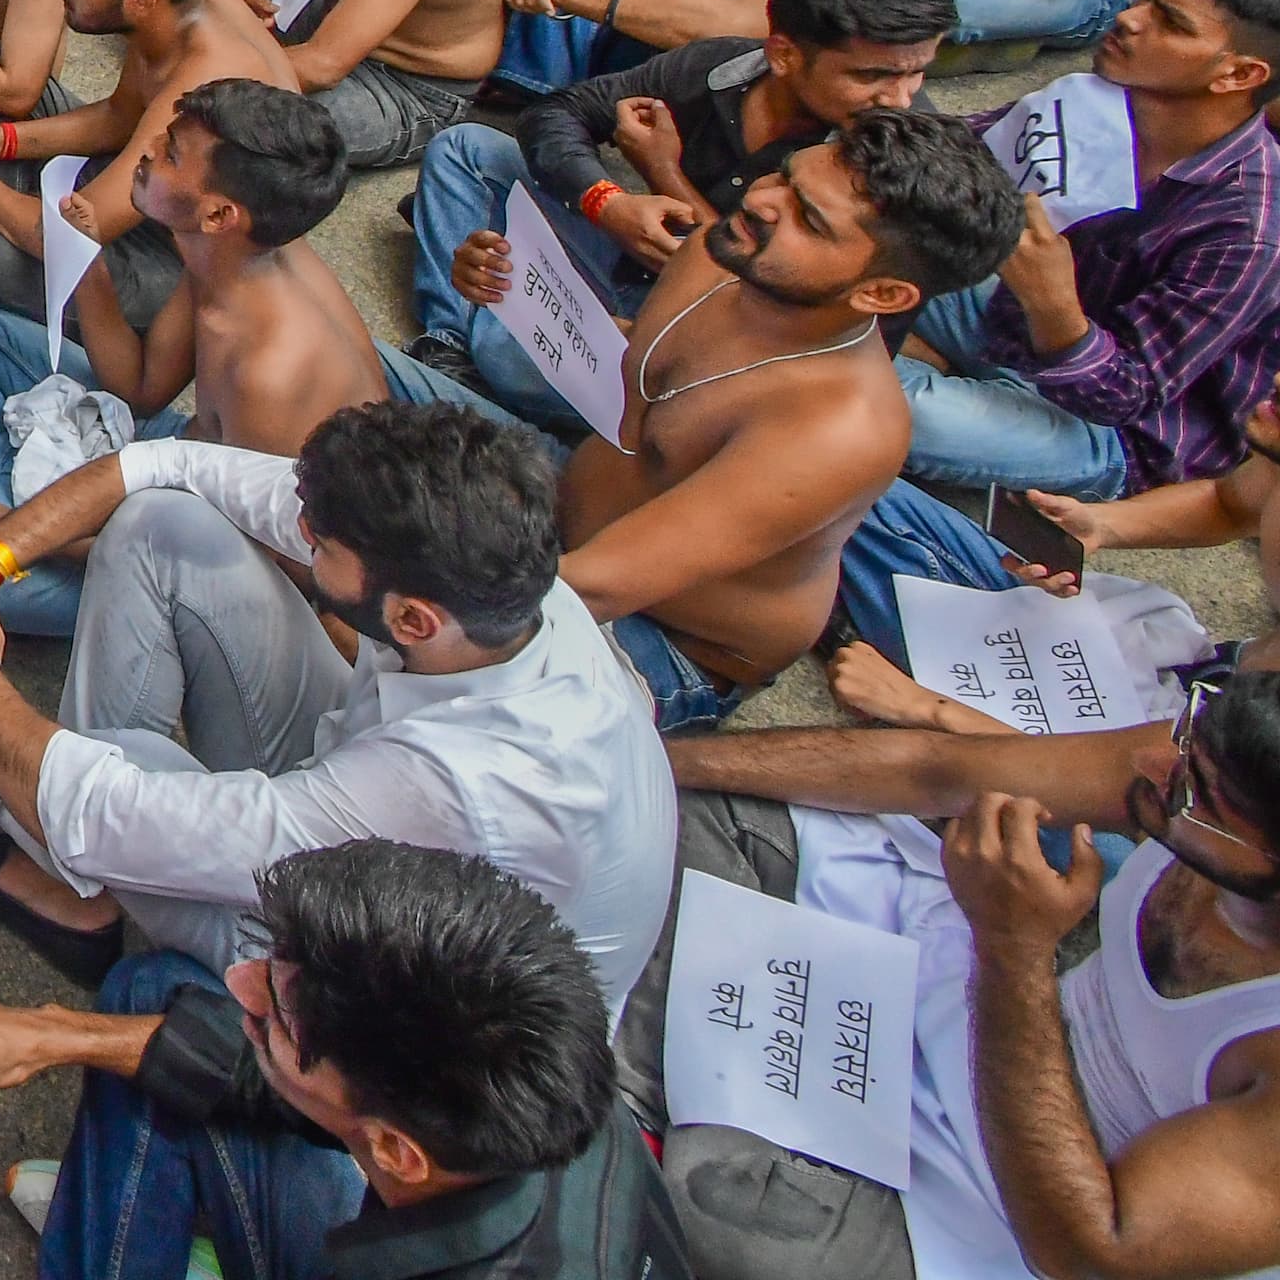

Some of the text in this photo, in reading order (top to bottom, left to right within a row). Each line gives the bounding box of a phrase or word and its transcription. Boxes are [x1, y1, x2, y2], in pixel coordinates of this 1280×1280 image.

[523, 262, 598, 374] चुनाव बहाल
[533, 324, 563, 373] करो
[948, 663, 996, 700] करो
[984, 628, 1034, 681] चुनाव
[1051, 639, 1107, 719] छात्रसंघ
[707, 984, 754, 1031] करो
[763, 960, 811, 1100] चुनाव बहाल
[831, 999, 877, 1104] छात्रसंघ
